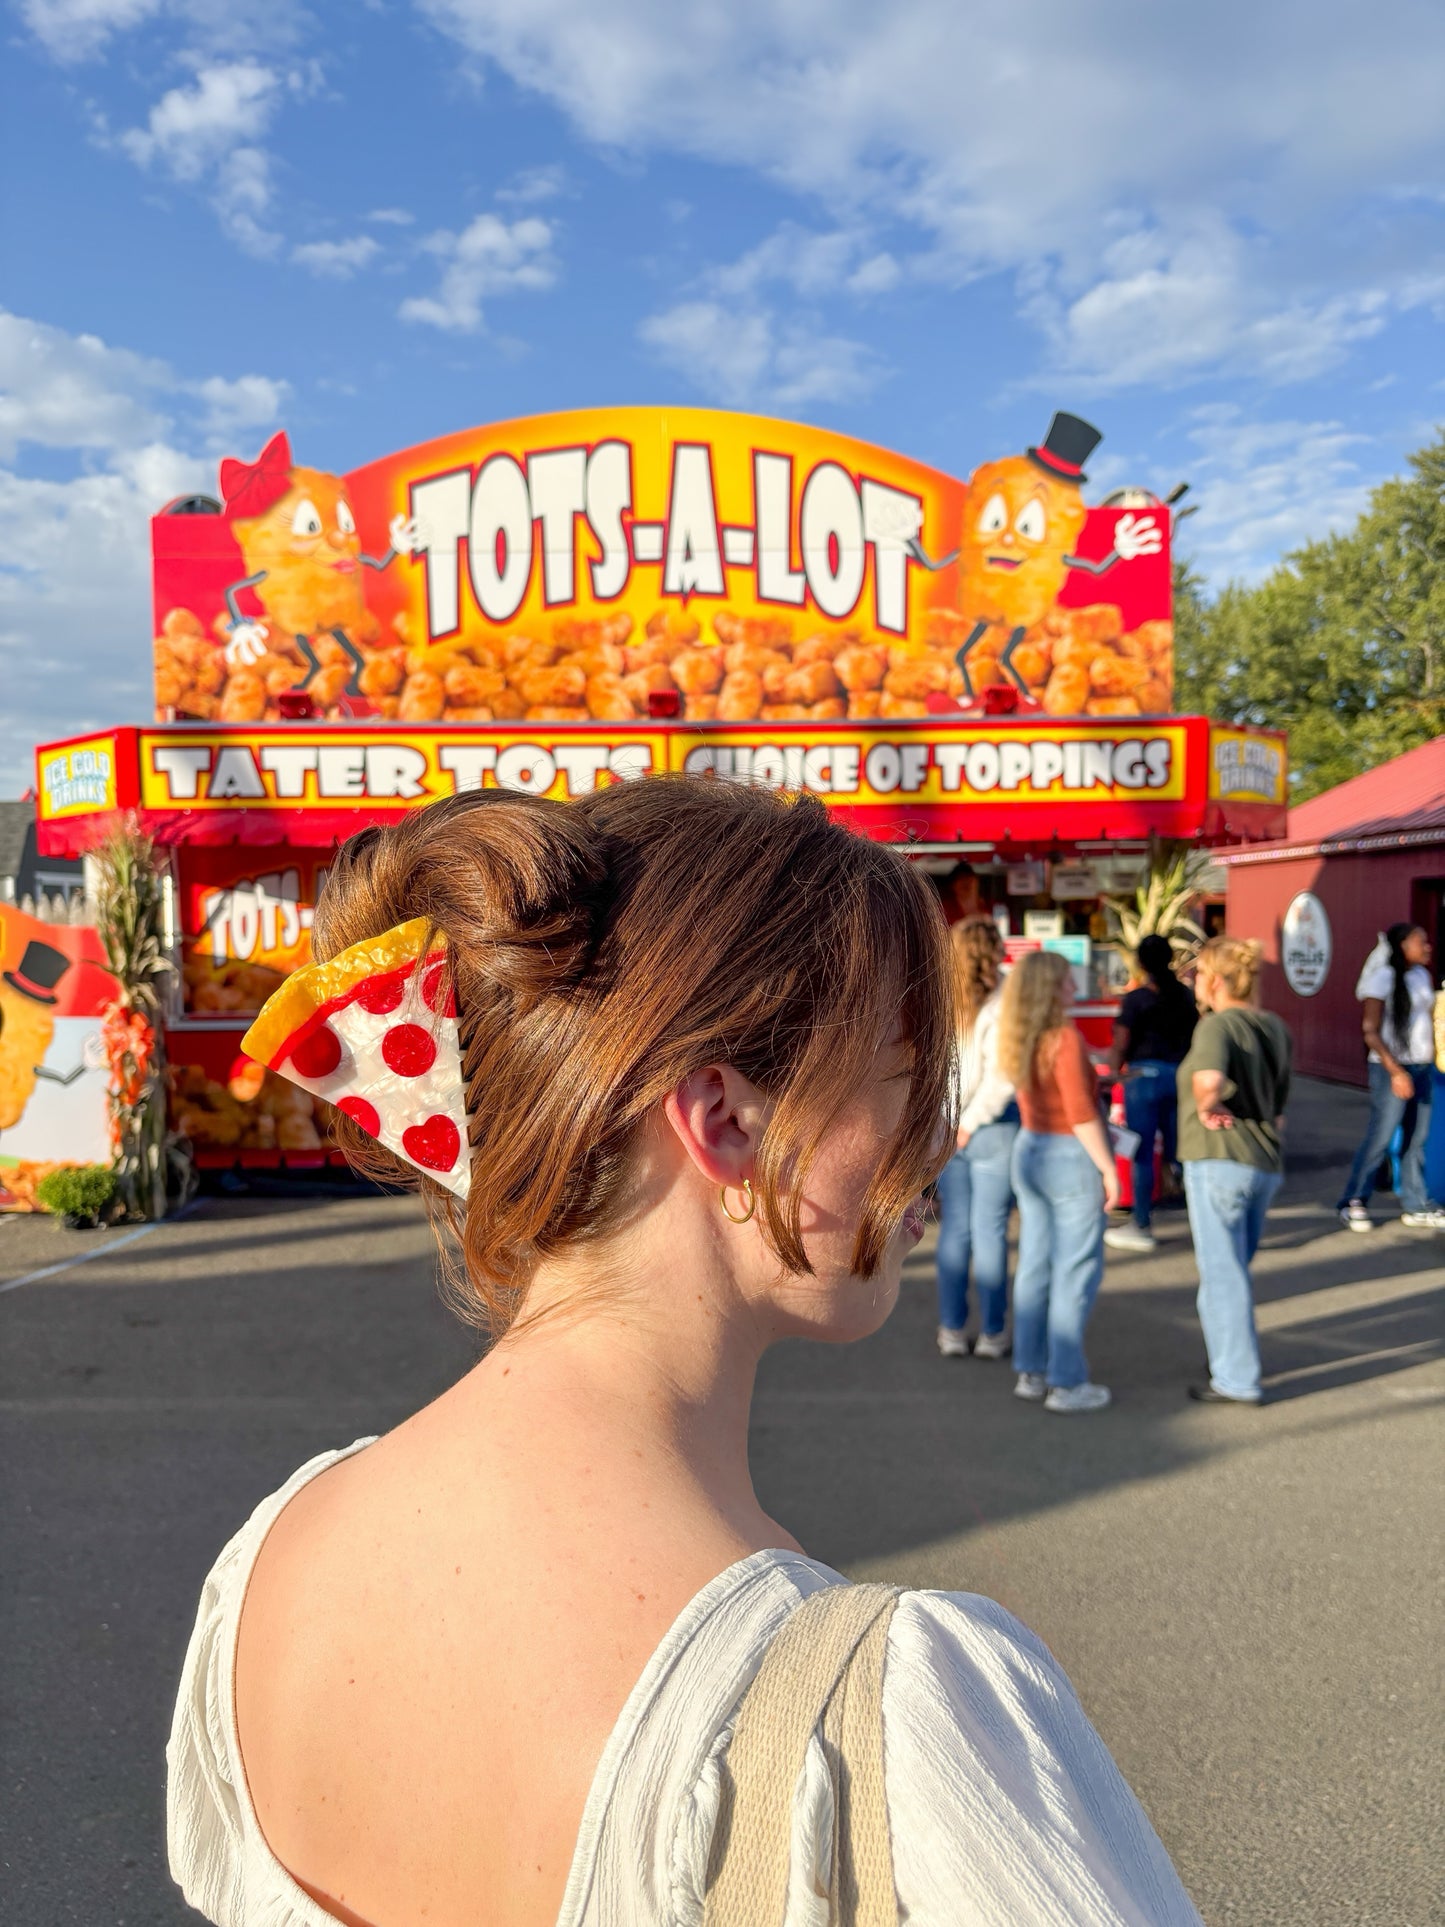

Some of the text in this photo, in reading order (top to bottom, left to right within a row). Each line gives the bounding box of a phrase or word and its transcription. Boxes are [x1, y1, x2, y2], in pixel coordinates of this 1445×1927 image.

[409, 439, 923, 640] TOTS-A-LOT
[44, 750, 110, 792] ICE COLD
[154, 744, 651, 799] TATER TOTS
[685, 739, 1170, 793] CHOICE OF TOPPINGS
[51, 778, 107, 813] DRINKS
